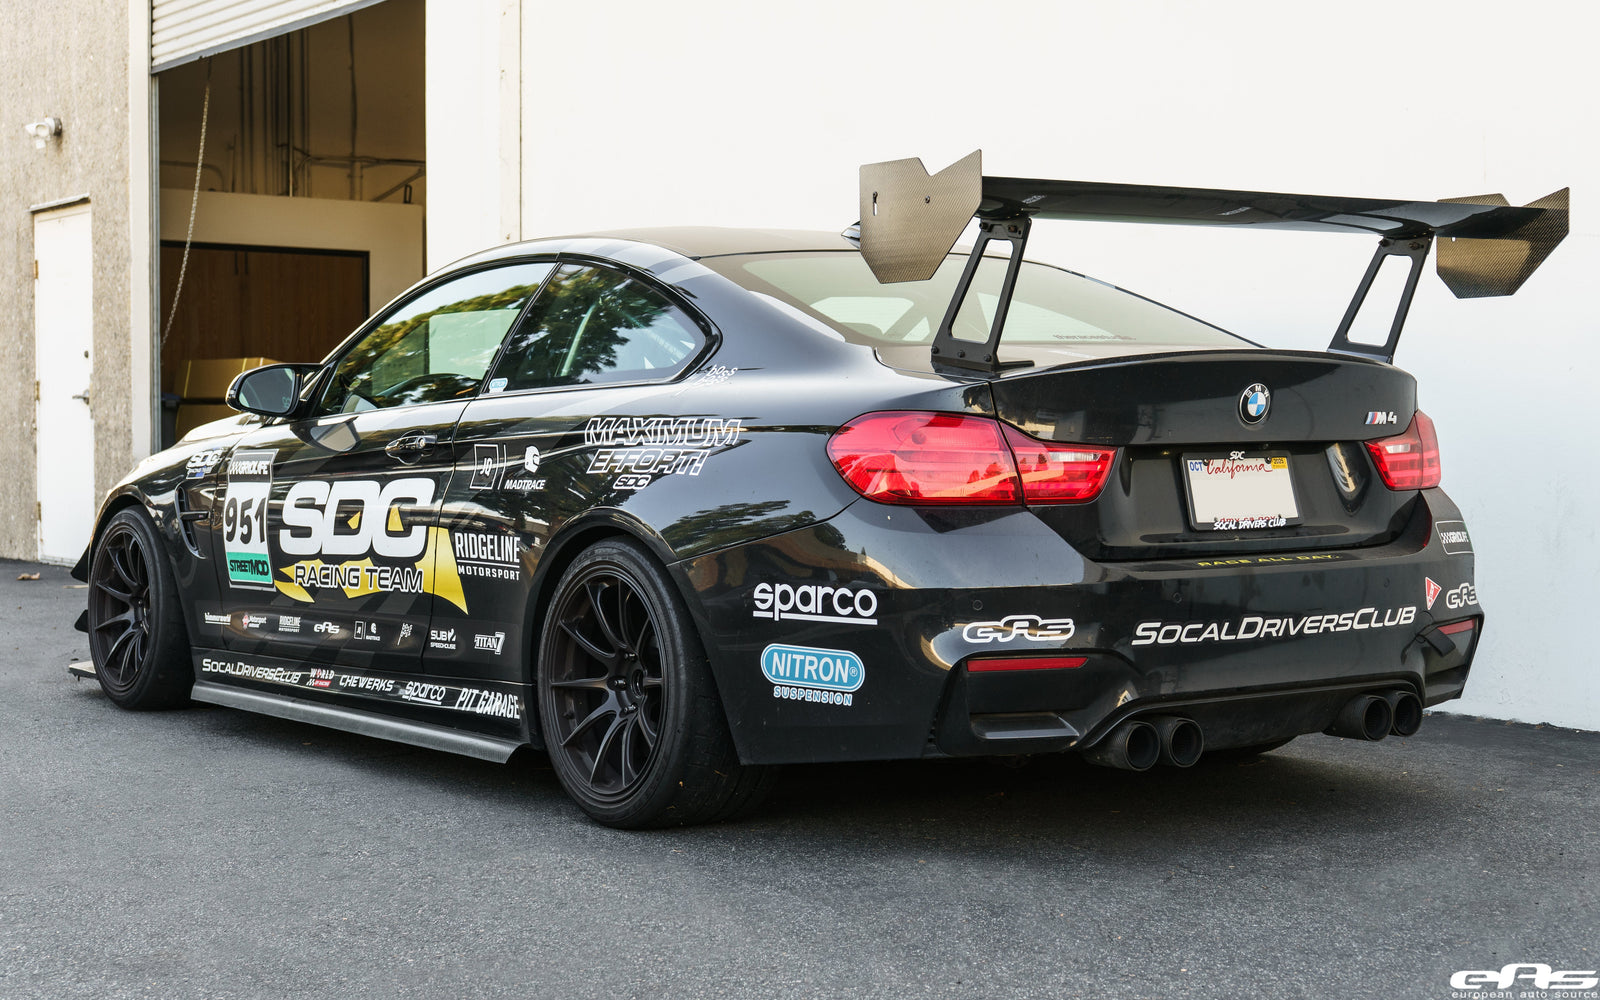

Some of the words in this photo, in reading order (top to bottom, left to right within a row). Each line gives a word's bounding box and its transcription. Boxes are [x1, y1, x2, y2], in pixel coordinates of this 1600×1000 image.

[1245, 384, 1270, 398] BMW
[1366, 411, 1397, 425] M4
[584, 416, 742, 447] MAXIMUM
[586, 448, 711, 476] EFFORT!
[1229, 451, 1245, 460] SDC
[1189, 461, 1203, 472] OCT
[1206, 458, 1273, 479] California
[504, 479, 546, 490] MADTRACE
[613, 474, 652, 490] SDC
[225, 497, 267, 545] 951
[279, 477, 436, 558] SDC
[1213, 520, 1237, 530] SOCAL
[1238, 519, 1267, 530] DRIVERS
[1268, 517, 1287, 528] CLUB
[454, 532, 521, 564] RIDGELINE
[1198, 558, 1252, 567] RACE
[294, 564, 360, 589] RACING
[365, 566, 424, 594] TEAM
[457, 565, 521, 582] MOTORSPORT
[753, 582, 878, 622] sparco
[309, 668, 335, 680] WORLD
[339, 674, 395, 692] CHEWERKS
[403, 681, 446, 703] sparco
[773, 685, 853, 707] SUSPENSION
[454, 687, 481, 710] PIT
[476, 690, 520, 720] GARAGE
